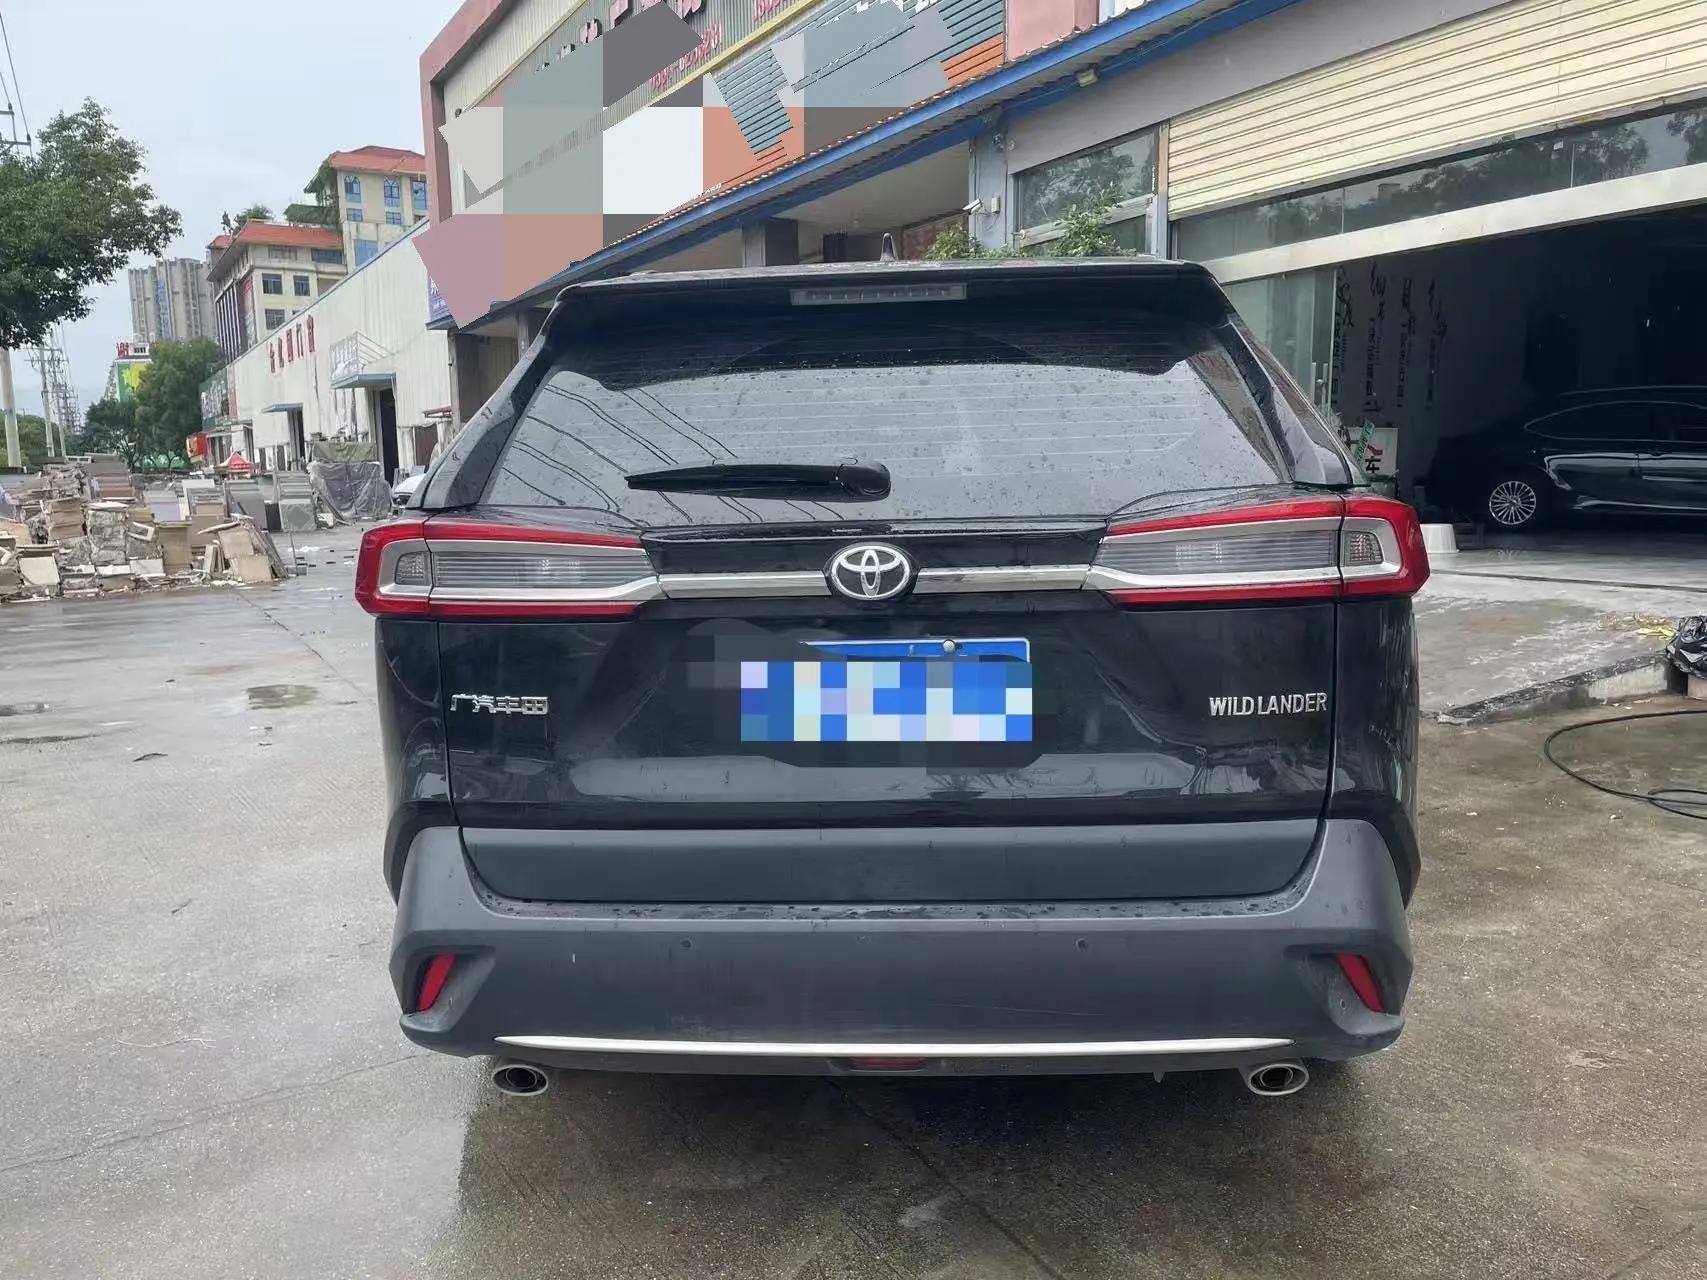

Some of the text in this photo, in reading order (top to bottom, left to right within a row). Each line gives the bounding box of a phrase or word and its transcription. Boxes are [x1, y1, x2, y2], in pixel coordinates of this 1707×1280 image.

[450, 693, 549, 715] 广汽丰田
[1208, 692, 1328, 716] WILDLANDER
